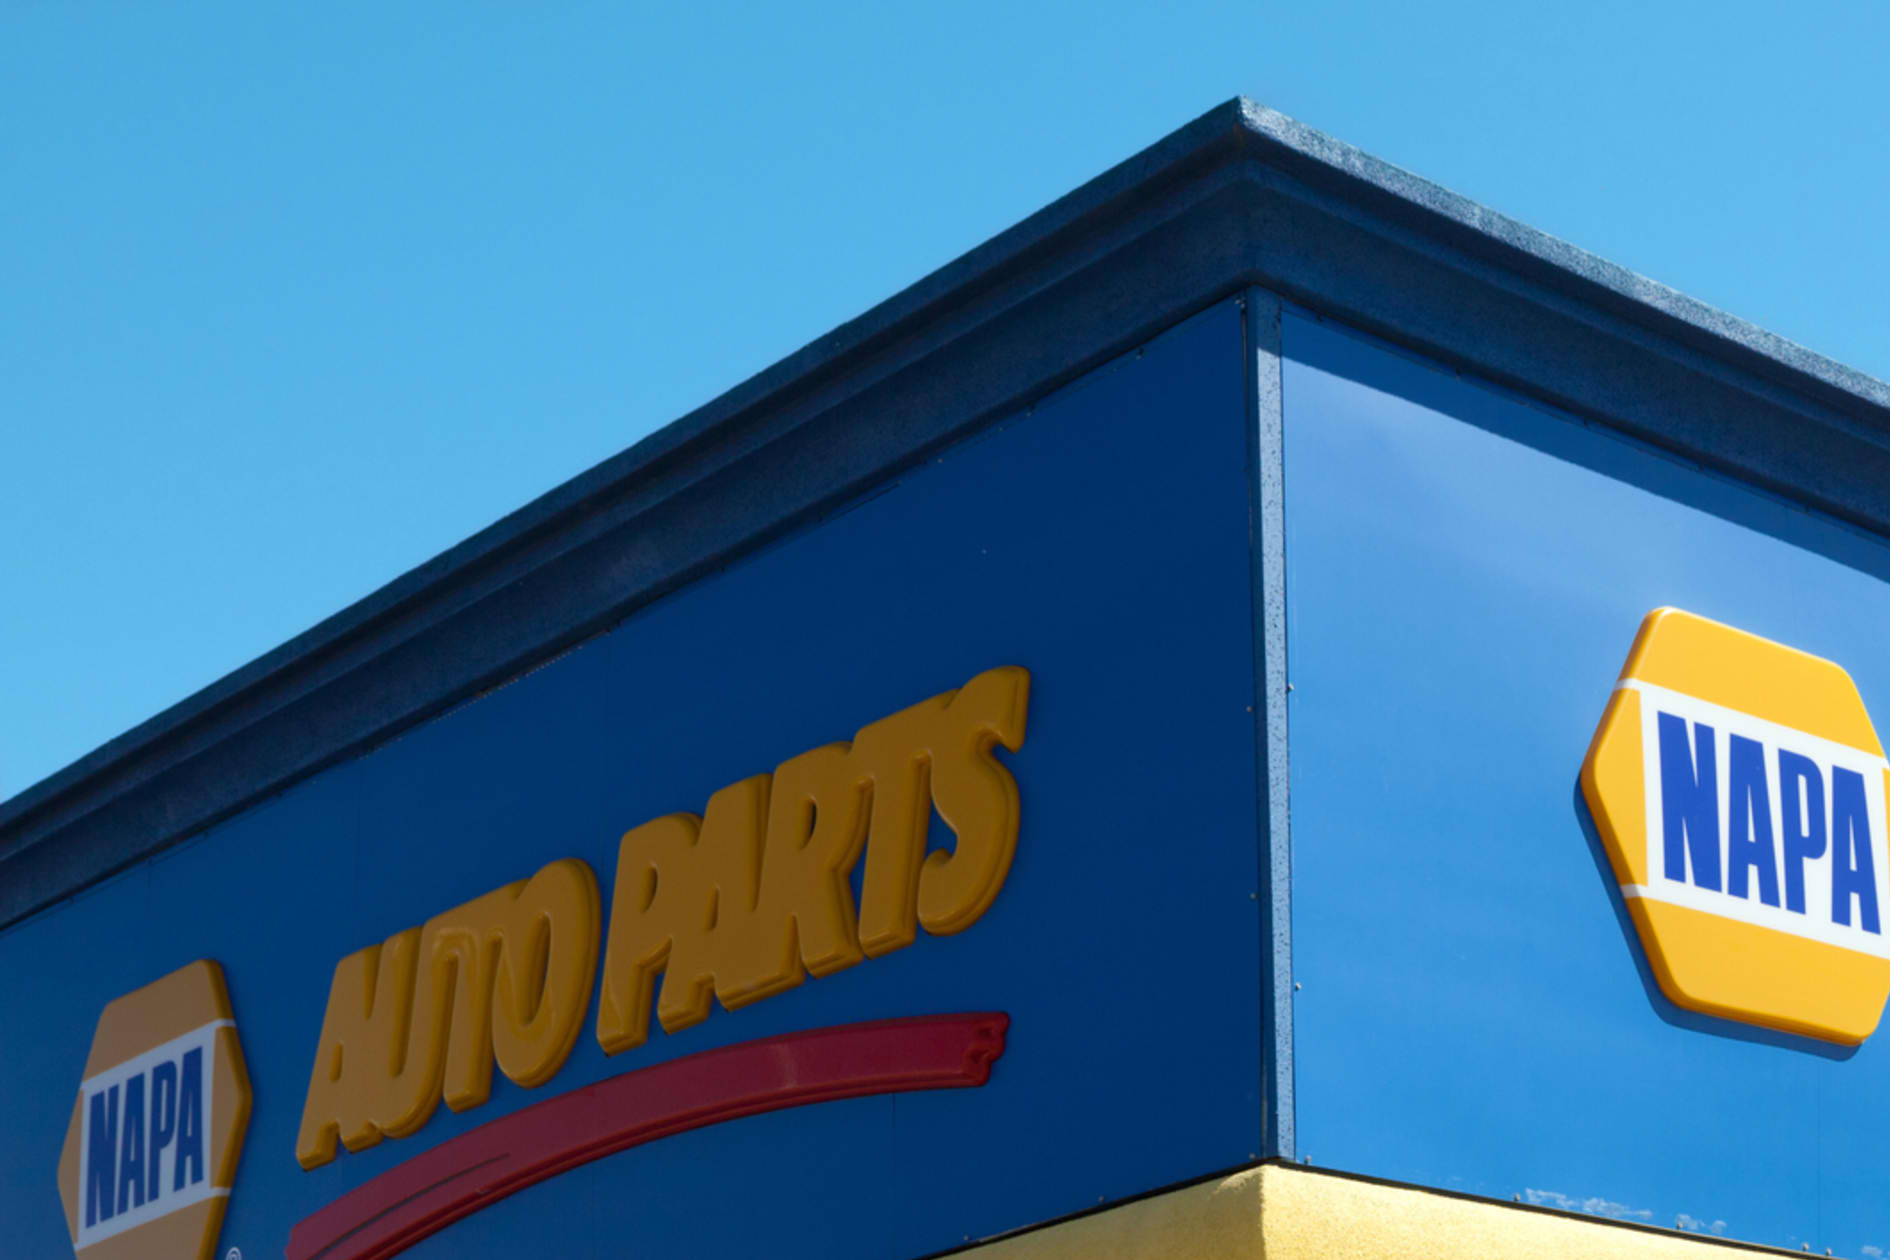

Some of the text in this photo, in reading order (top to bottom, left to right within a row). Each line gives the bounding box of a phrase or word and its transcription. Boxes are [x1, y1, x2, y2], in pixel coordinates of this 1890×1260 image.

[296, 665, 1030, 1171] AUTO PARTS
[1657, 710, 1881, 935] NAPA
[86, 1046, 204, 1230] NAPA
